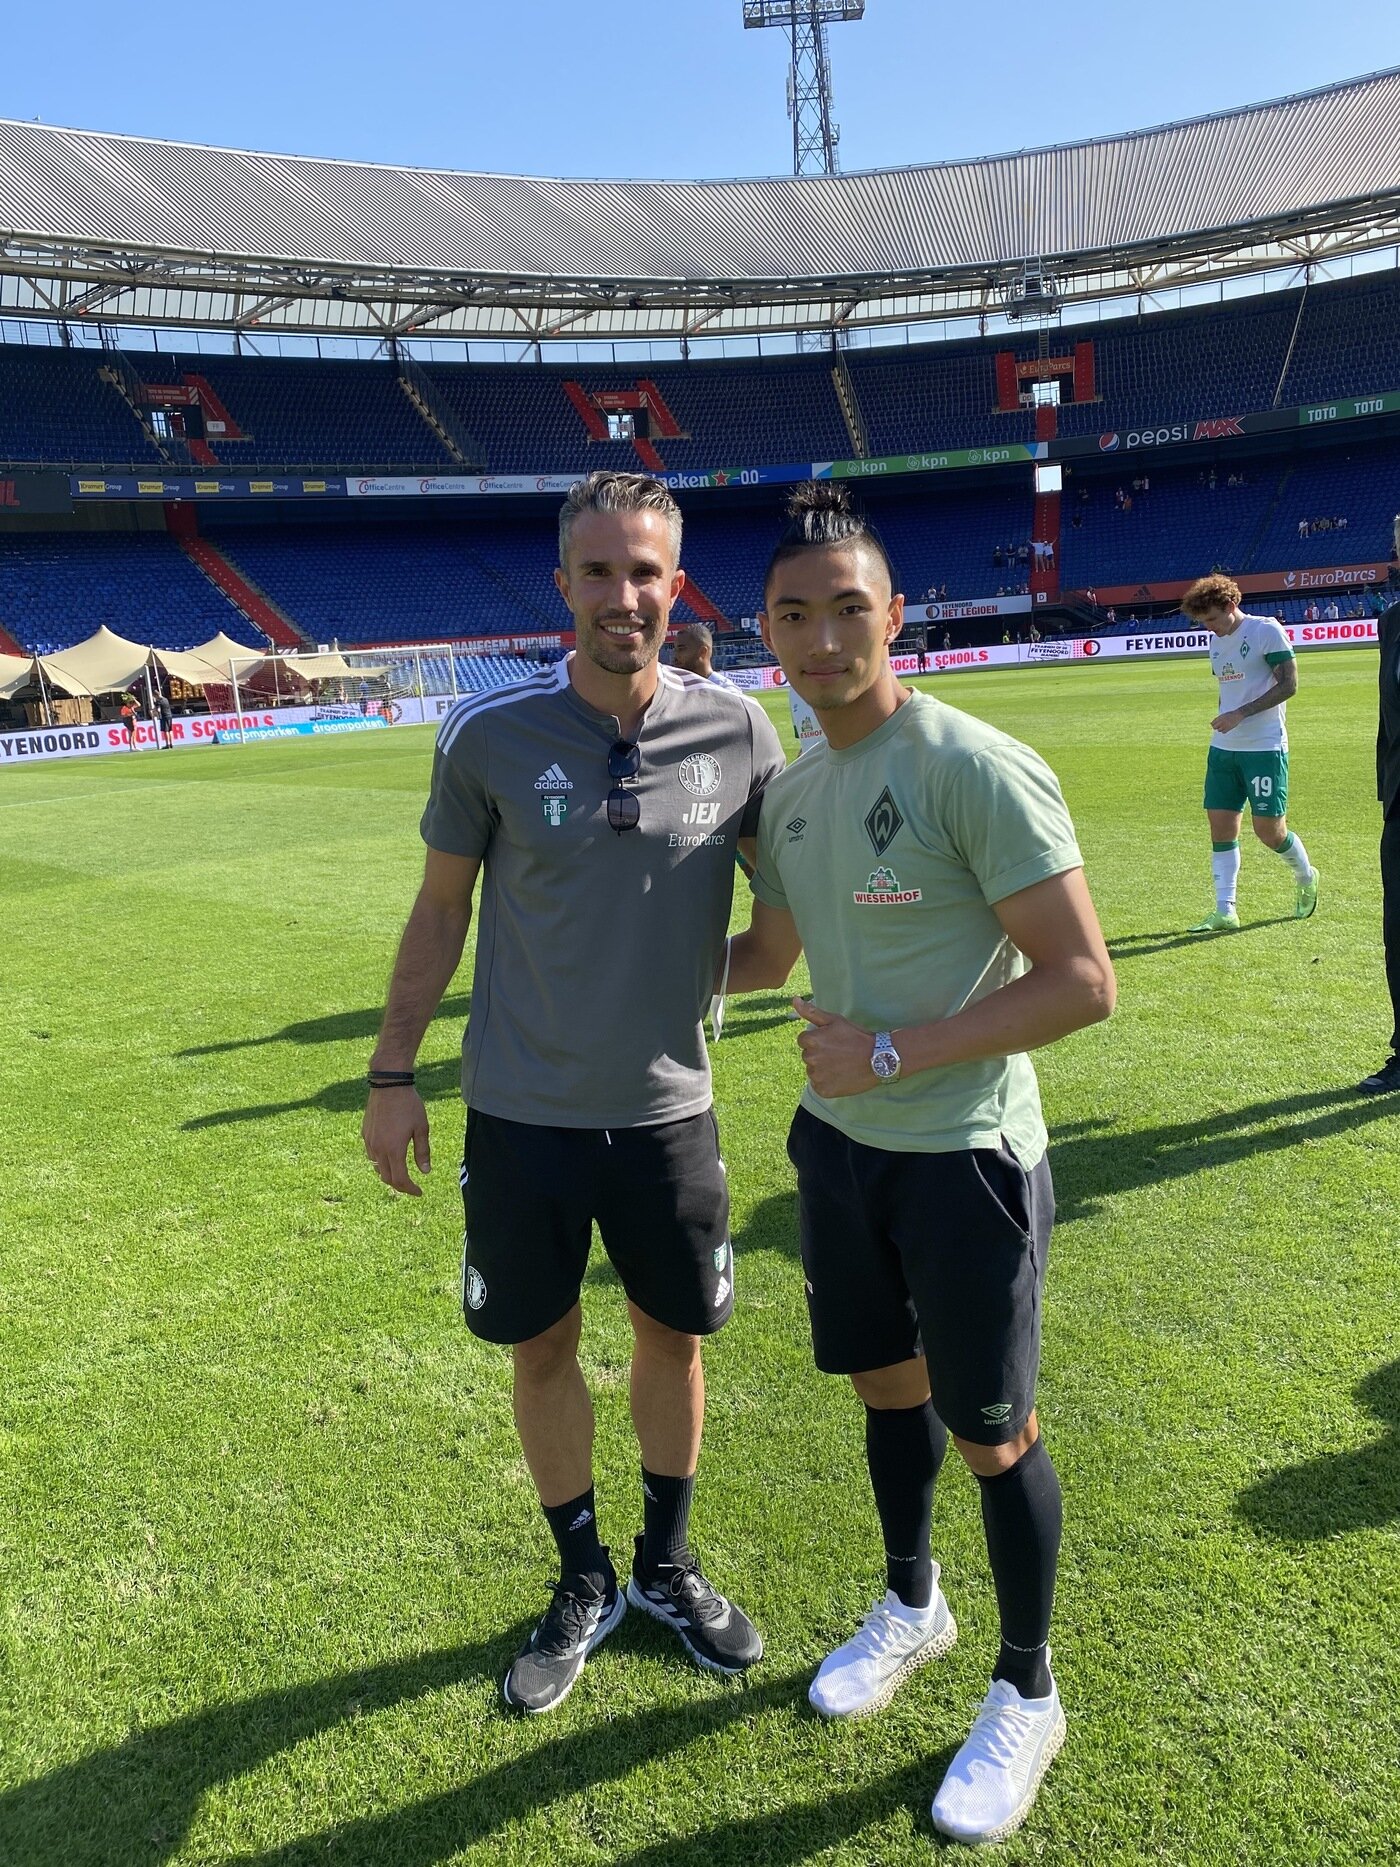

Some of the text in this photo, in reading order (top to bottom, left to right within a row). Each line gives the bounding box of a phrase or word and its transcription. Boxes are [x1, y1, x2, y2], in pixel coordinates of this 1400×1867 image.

[1307, 406, 1337, 421] TOTO
[1354, 399, 1384, 415] TOTO
[1126, 416, 1246, 449] pepsi MAX
[921, 455, 948, 469] kpn
[983, 449, 1010, 463] kpn
[861, 461, 887, 474] kpn
[656, 473, 710, 489] neken
[1300, 568, 1376, 587] EuroParcs
[941, 601, 973, 609] FEYENOORD
[1038, 593, 1045, 601] D
[942, 605, 998, 618] HET LEGIOEN
[1302, 623, 1378, 640] SCHOOL
[889, 650, 988, 672] SOCCR SCHOOLS
[313, 718, 384, 734] droomparken
[107, 723, 185, 746] SOCCR
[0, 731, 100, 757] YENOORD
[534, 779, 574, 790] adidas
[684, 778, 719, 794] ROTTERDAM
[1251, 775, 1273, 797] 19
[682, 802, 721, 825] JEX
[668, 832, 726, 847] EuroParcs
[855, 890, 920, 904] WIESENHOF
[984, 1415, 1010, 1425] umbro
